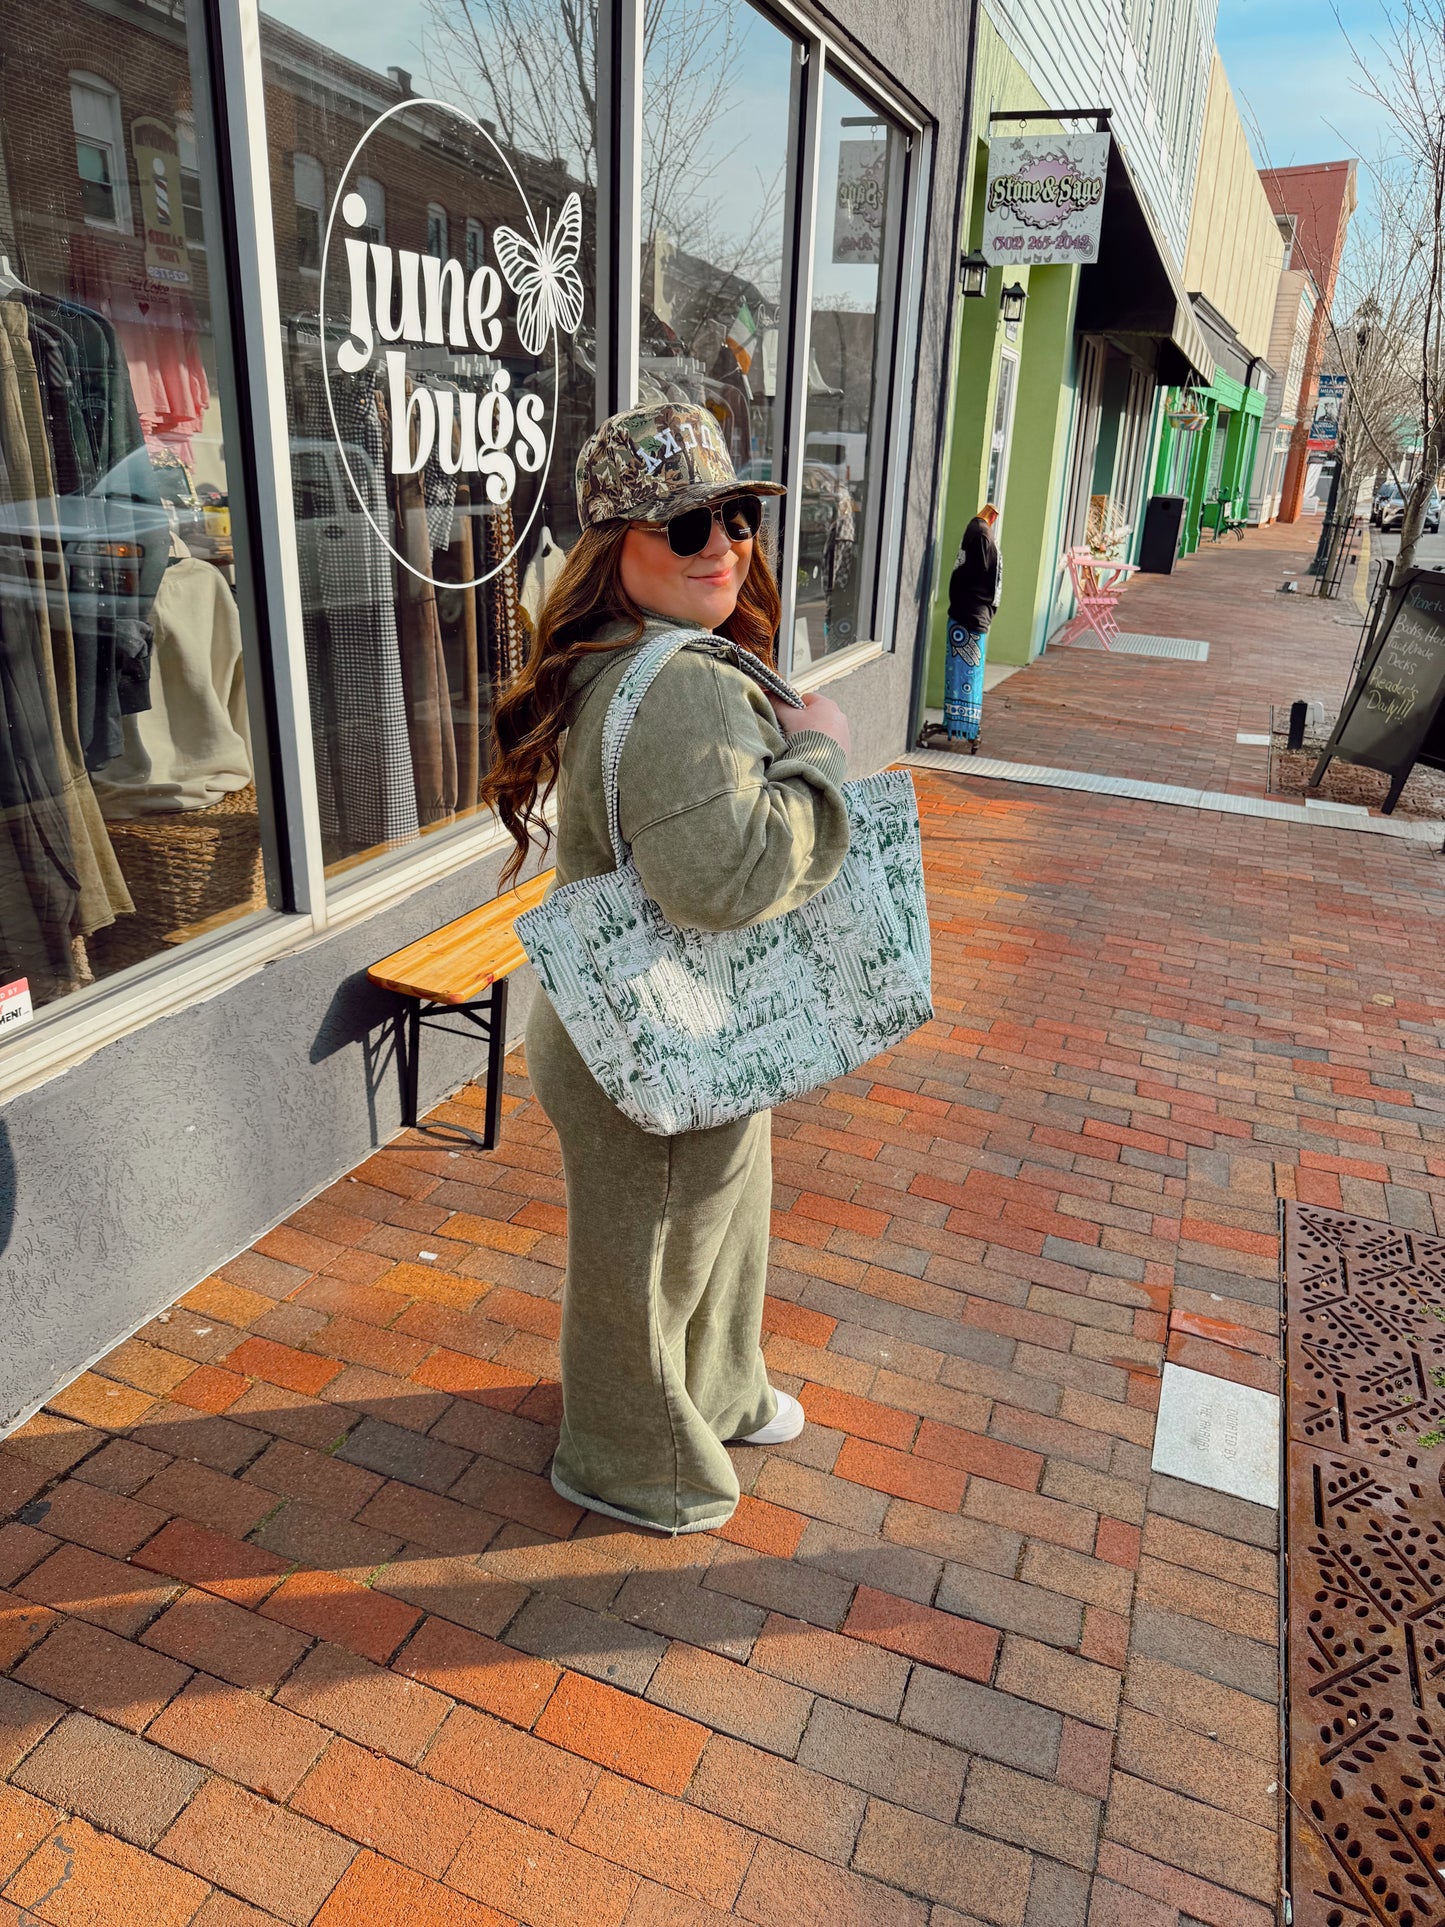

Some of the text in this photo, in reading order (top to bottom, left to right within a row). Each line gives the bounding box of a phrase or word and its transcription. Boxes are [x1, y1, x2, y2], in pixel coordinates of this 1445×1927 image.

[337, 193, 503, 373] june
[385, 351, 547, 505] bugs
[1369, 665, 1419, 703] Reader's
[1387, 652, 1418, 676] Decks
[8, 986, 18, 996] BY
[1223, 1408, 1238, 1462] DONATED BY
